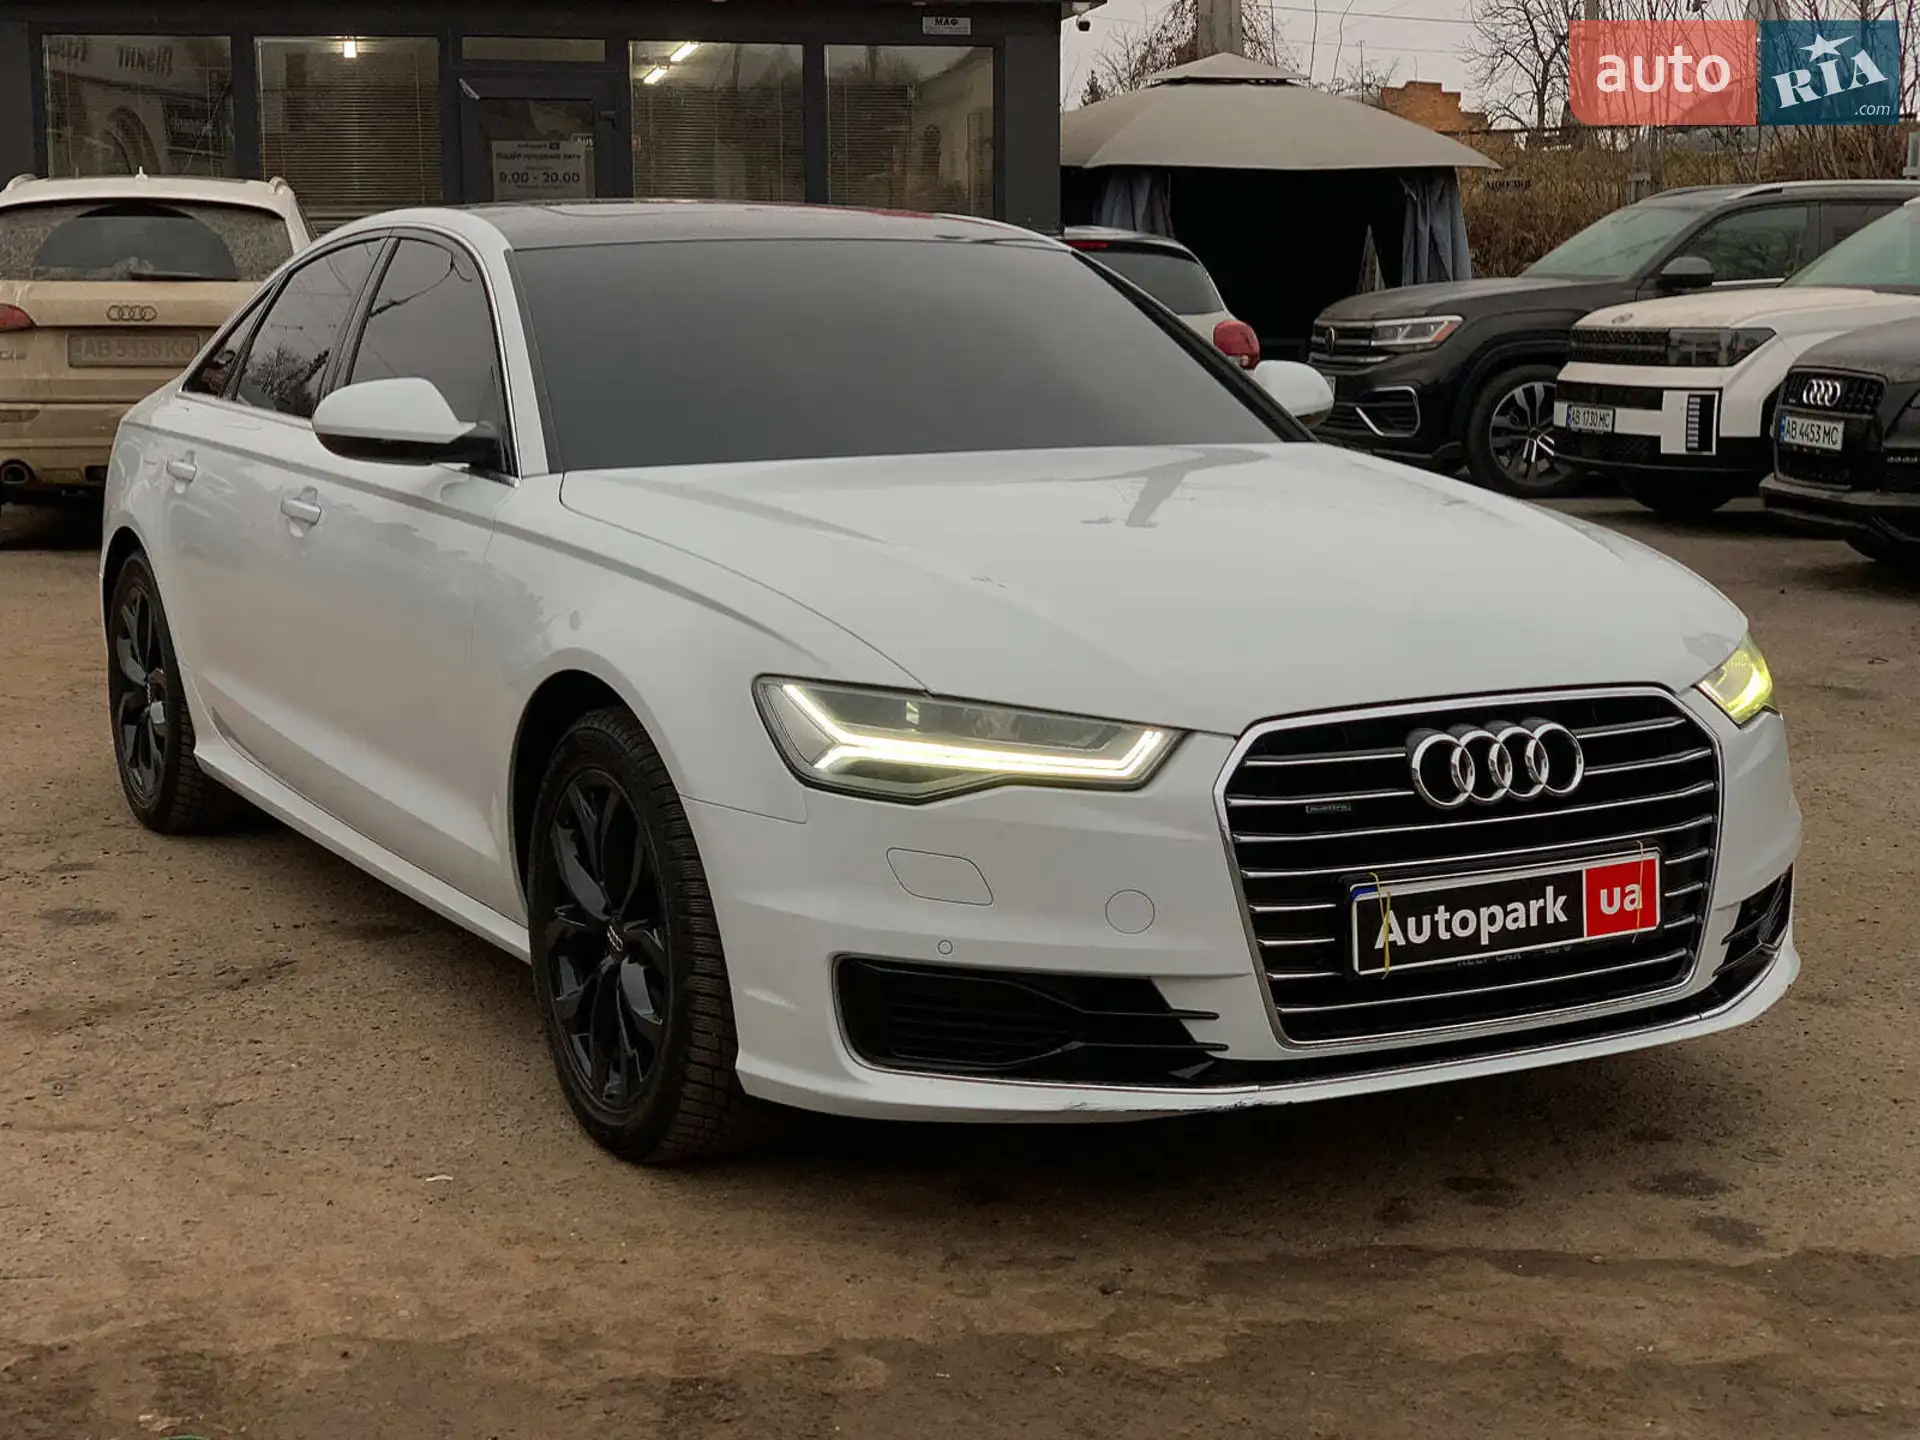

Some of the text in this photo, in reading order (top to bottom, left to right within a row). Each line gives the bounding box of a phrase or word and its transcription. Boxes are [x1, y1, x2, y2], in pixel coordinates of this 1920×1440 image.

[542, 171, 580, 184] 20.00
[1785, 419, 1839, 446] AB 4453 MC
[1374, 882, 1643, 950] Autopark ua
